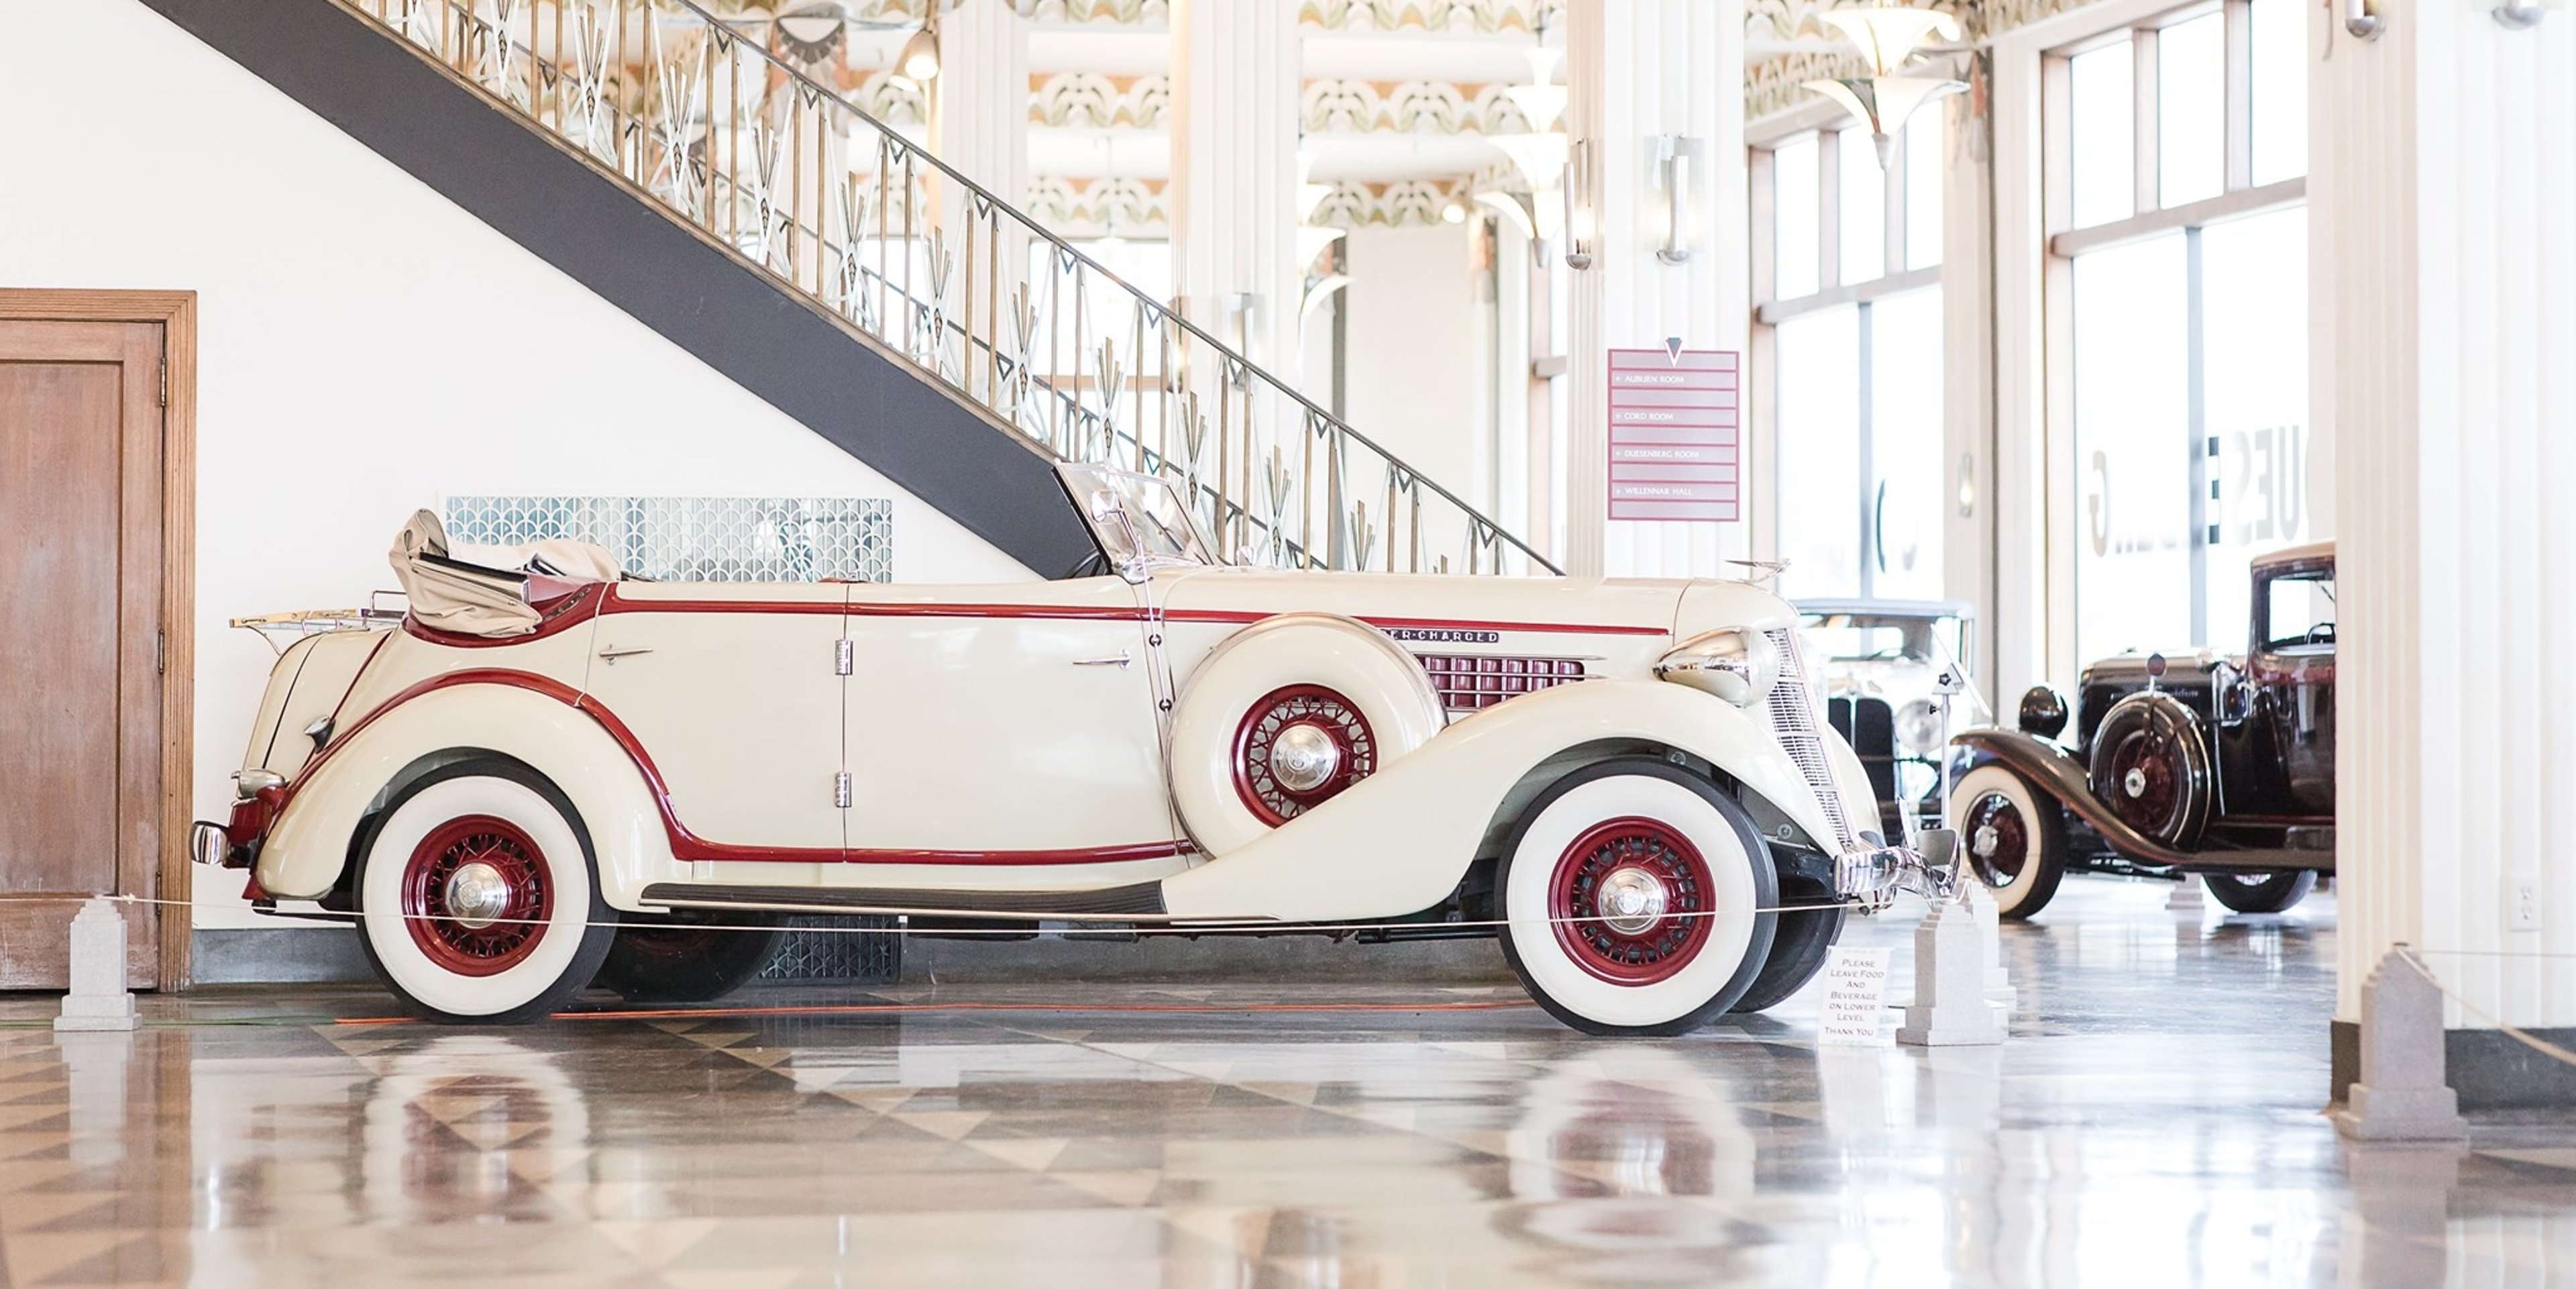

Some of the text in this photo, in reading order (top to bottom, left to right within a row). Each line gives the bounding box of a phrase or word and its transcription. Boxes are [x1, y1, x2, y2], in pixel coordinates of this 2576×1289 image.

[1624, 375, 1658, 383] AUBURN
[1624, 450, 1672, 458] DUESENBERG
[1672, 488, 1692, 496] HALL
[1389, 629, 1498, 642] ER-CHARGED
[1842, 959, 1876, 968] PLEASE
[1830, 970, 1884, 978] LEAVE FOOD
[1831, 991, 1878, 1000] BEVERAGE
[1825, 1027, 1874, 1036] THANK YOU
